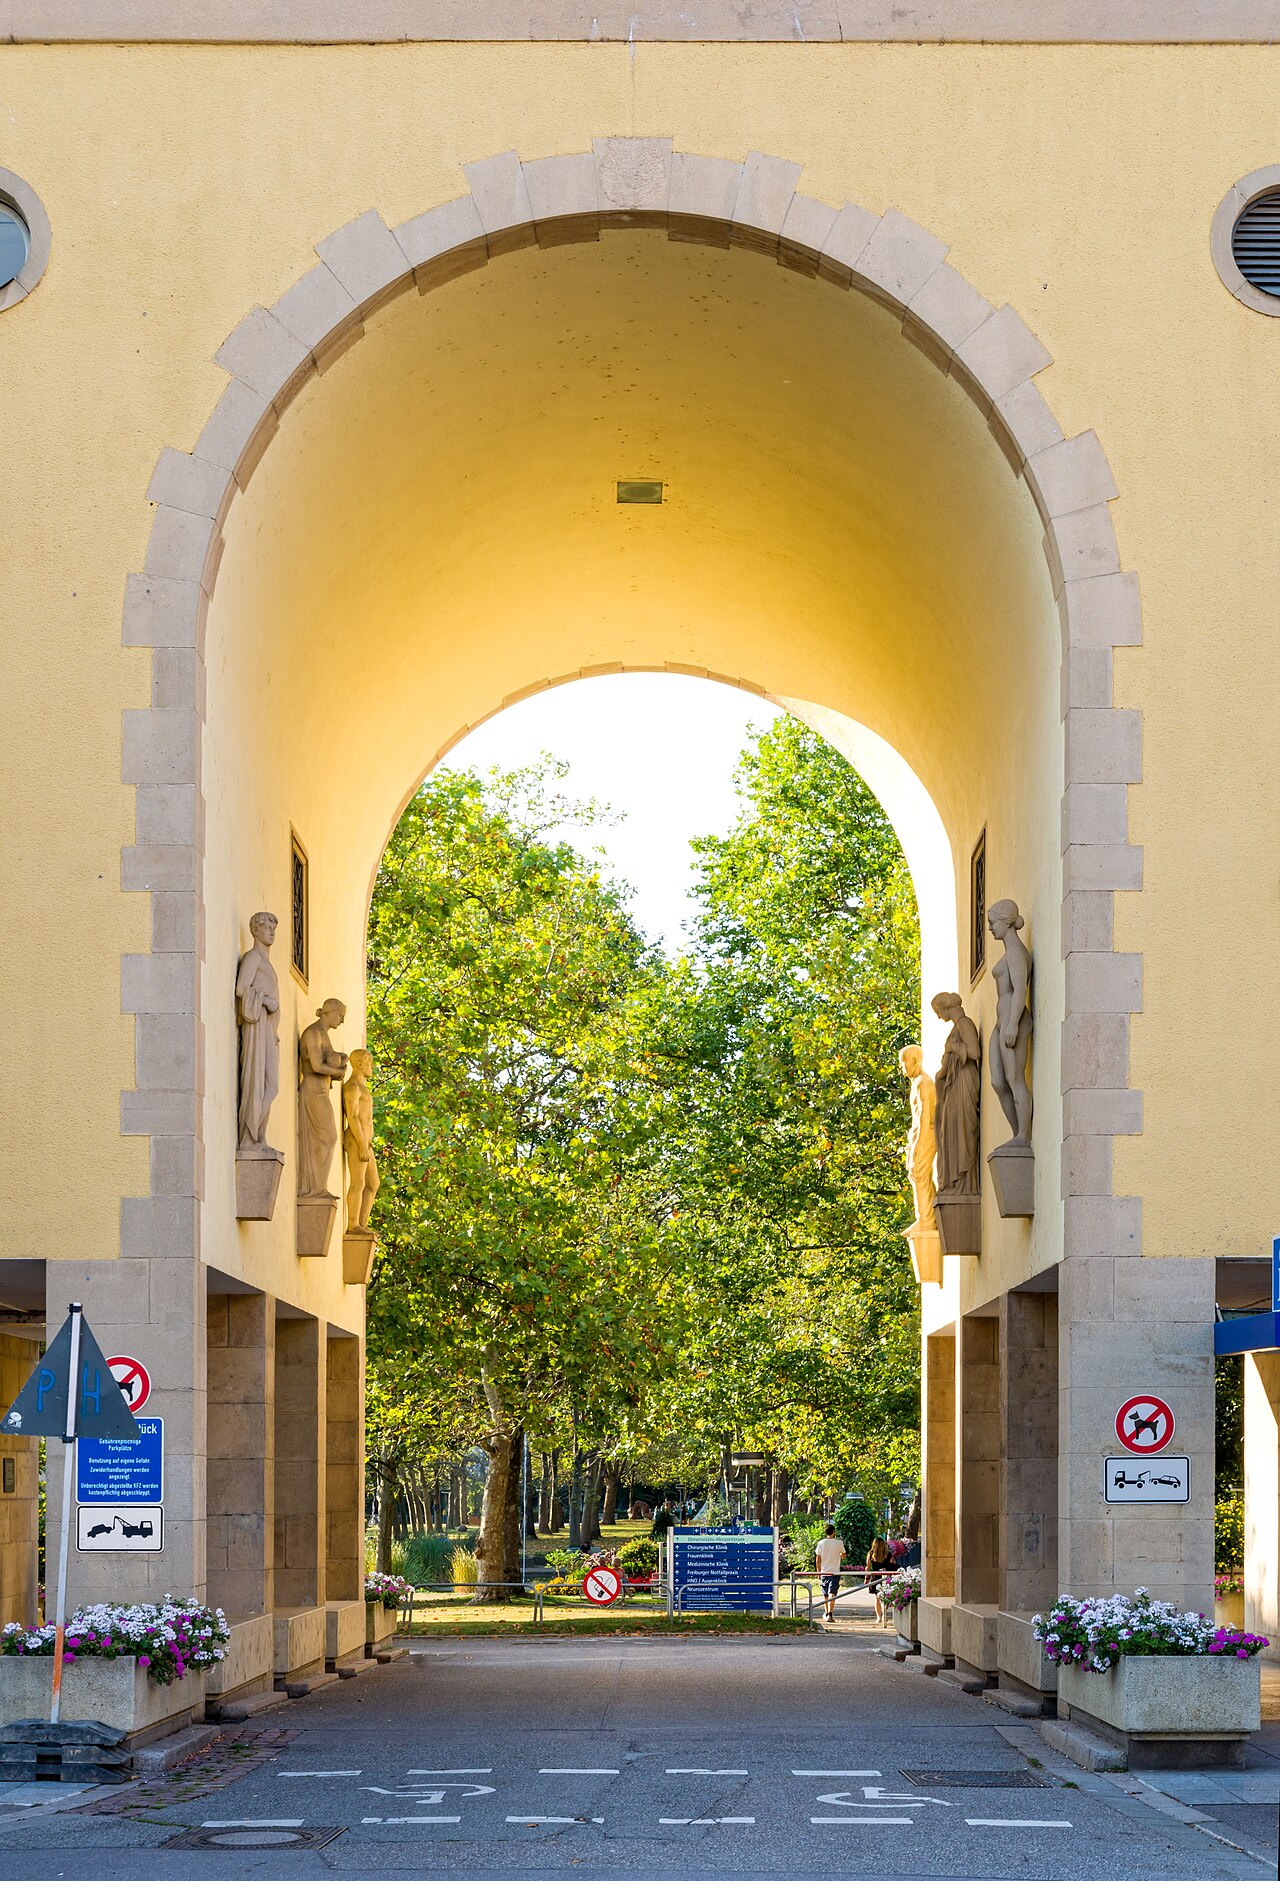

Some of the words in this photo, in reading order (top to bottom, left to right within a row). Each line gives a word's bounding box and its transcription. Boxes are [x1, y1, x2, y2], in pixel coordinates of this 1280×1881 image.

[36, 1368, 56, 1412] P
[81, 1360, 101, 1418] H
[88, 1457, 112, 1465] Benutzung
